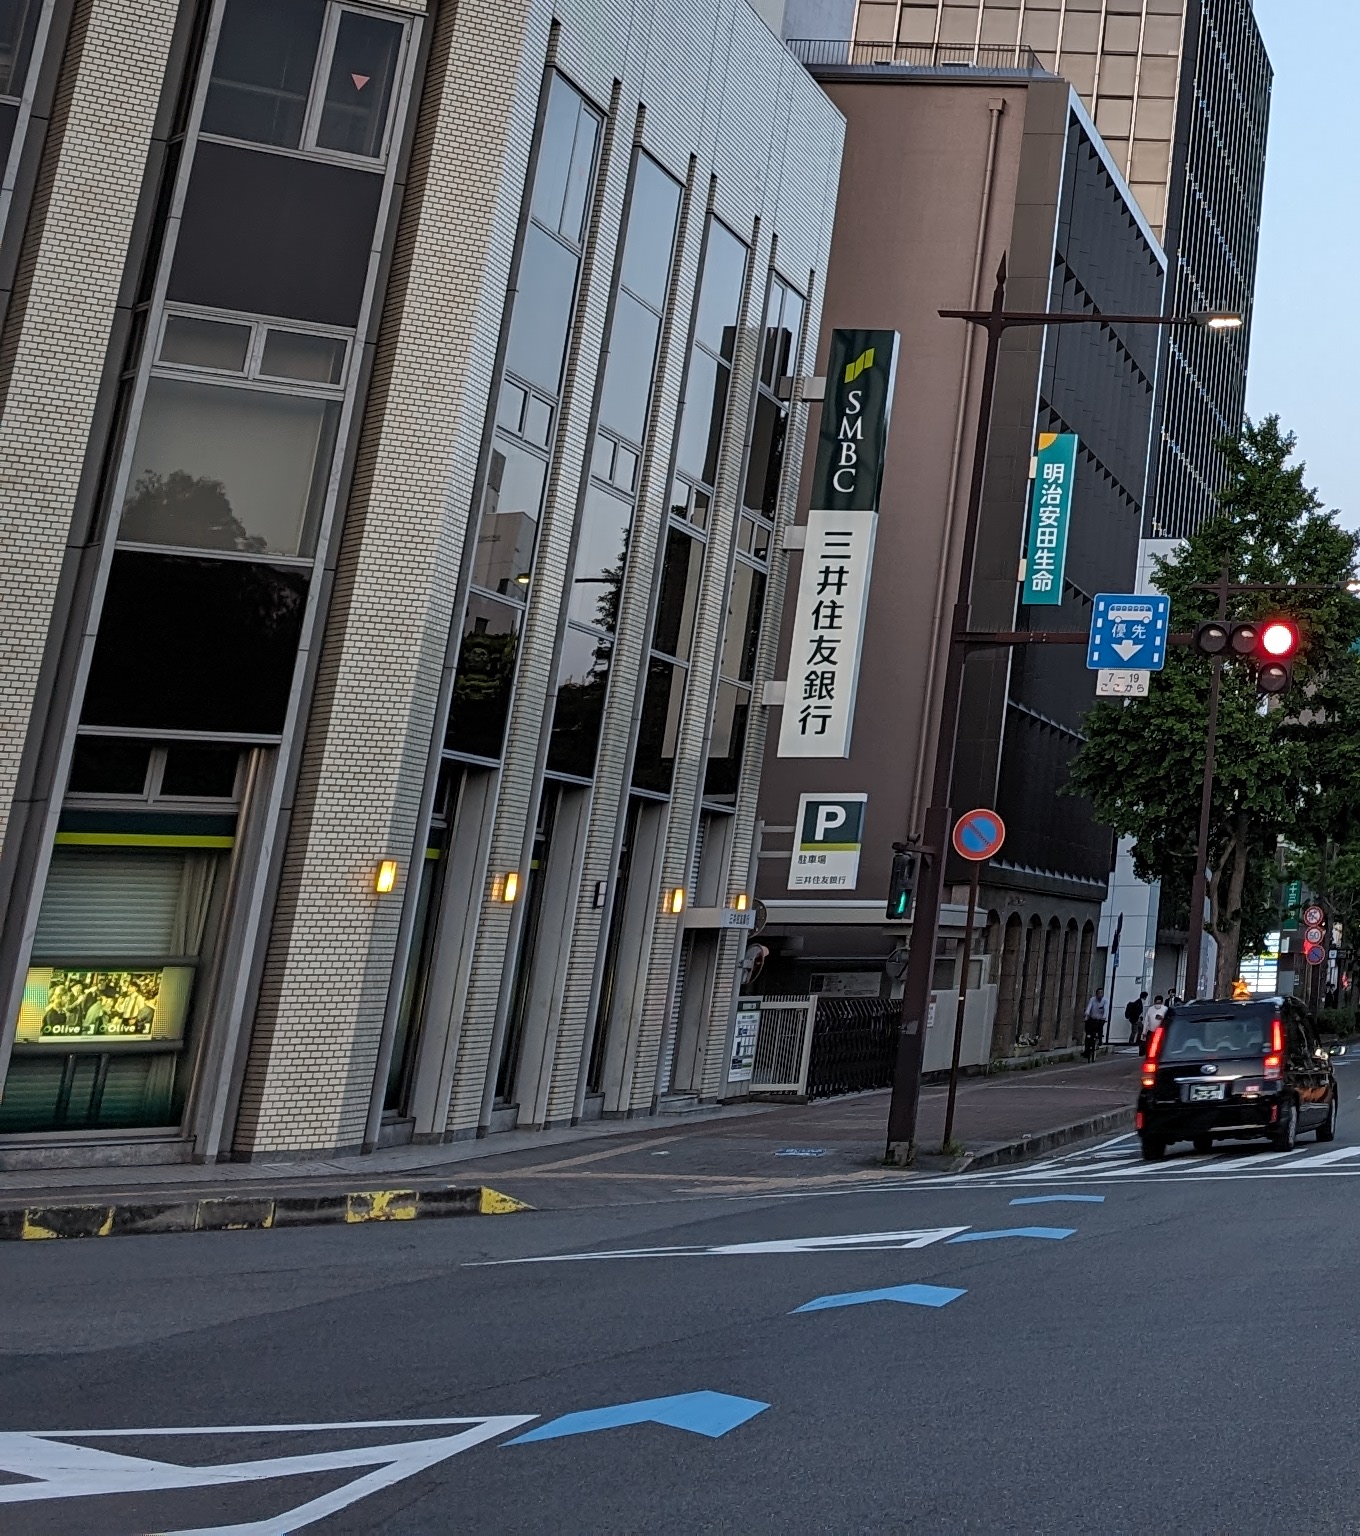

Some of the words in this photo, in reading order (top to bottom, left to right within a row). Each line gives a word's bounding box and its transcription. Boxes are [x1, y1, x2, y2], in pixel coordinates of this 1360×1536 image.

[832, 389, 865, 493] SMBC
[1031, 463, 1065, 592] 明治安田生命
[798, 531, 853, 736] 三井住友銀行
[1111, 623, 1147, 639] 優先
[1100, 683, 1145, 694] ここから
[814, 805, 847, 841] P
[797, 854, 827, 865] 駐車場
[794, 875, 847, 885] 三井住友銀行
[52, 1024, 81, 1034] Olive
[108, 1023, 136, 1033] Olive
